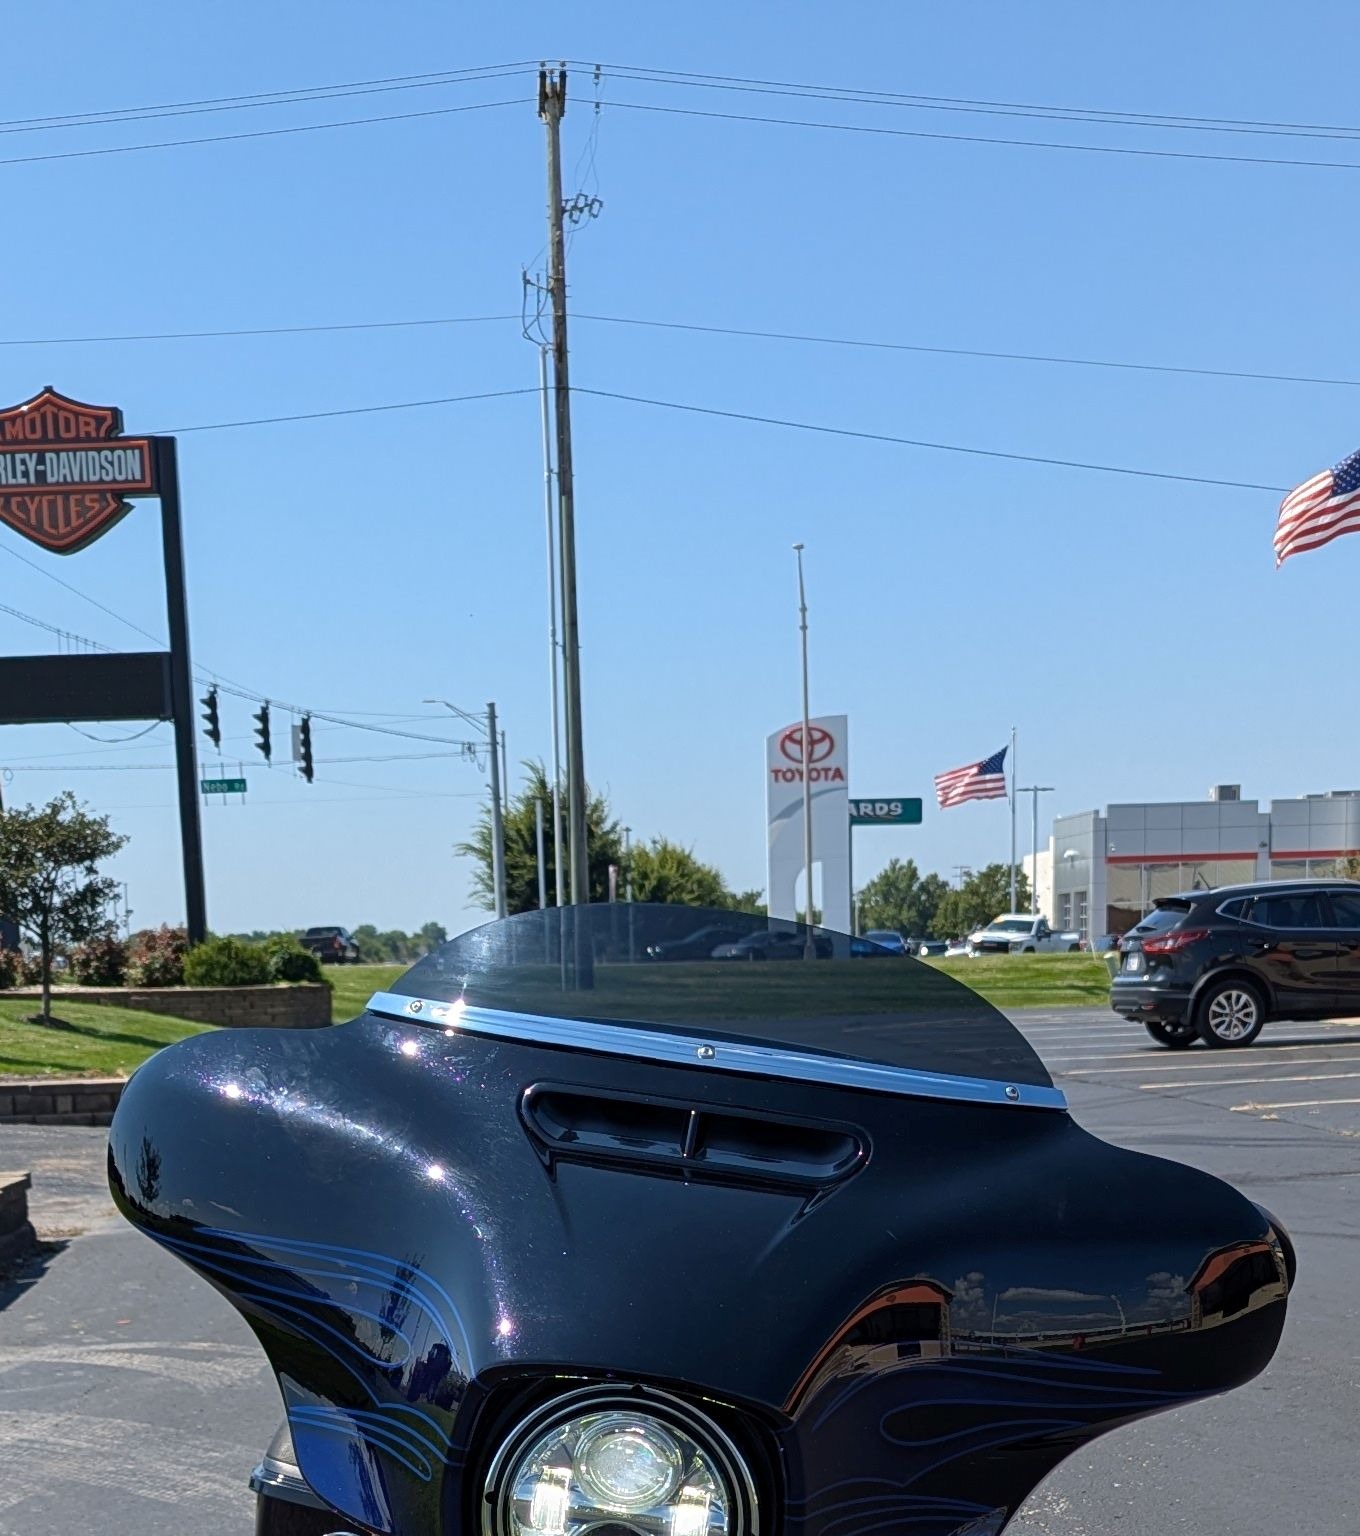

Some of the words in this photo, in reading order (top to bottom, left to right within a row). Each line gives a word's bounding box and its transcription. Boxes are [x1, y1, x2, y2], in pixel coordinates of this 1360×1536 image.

[4, 405, 97, 440] MOTOR
[11, 494, 99, 535] CYCLES
[771, 767, 845, 783] TOYOTA
